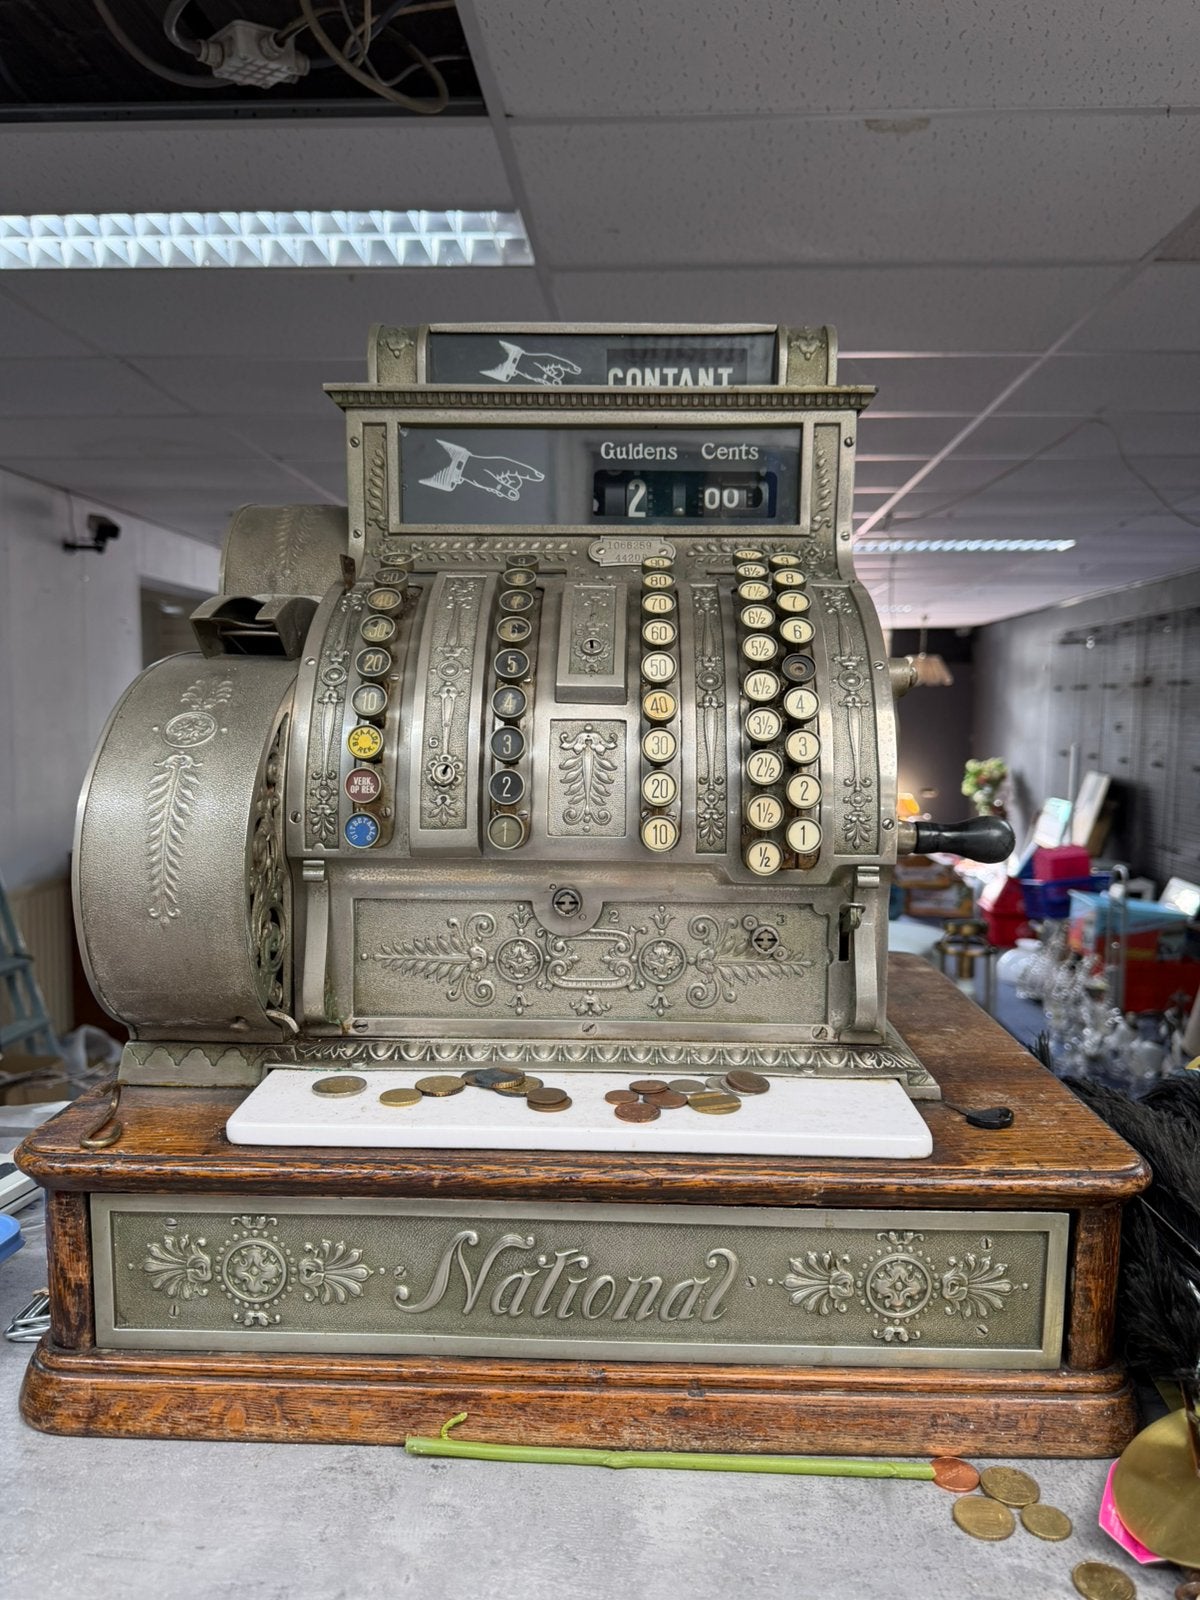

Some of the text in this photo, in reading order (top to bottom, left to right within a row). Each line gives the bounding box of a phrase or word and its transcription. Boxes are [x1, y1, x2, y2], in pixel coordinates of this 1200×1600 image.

[608, 367, 733, 386] CONTANT
[600, 441, 759, 460] Guldens Cents
[627, 479, 647, 518] 2
[650, 559, 665, 568] 90
[743, 567, 760, 576] 8½
[650, 576, 667, 586] 80
[785, 574, 794, 583] 8
[747, 586, 764, 597] 7½
[651, 598, 667, 611] 70
[789, 596, 797, 609] 7
[748, 610, 766, 624] 6½
[651, 626, 667, 641] 60
[793, 625, 802, 639] 6
[751, 640, 769, 656] 5½
[364, 654, 383, 671] 20
[507, 655, 517, 673] 5
[650, 659, 667, 677] 50
[752, 677, 772, 696] 4½
[362, 692, 377, 710] 10
[503, 692, 514, 712] 4
[650, 696, 668, 714] 40
[796, 694, 805, 713] 4
[753, 715, 774, 735] 3½
[352, 729, 378, 747] BETAALDE
[429, 736, 439, 748] 6
[503, 734, 512, 755] 3
[652, 735, 668, 755] 30
[799, 737, 807, 756] 3
[756, 757, 775, 778] 2½
[350, 785, 377, 794] OP REK.
[353, 777, 374, 786] VERK.
[502, 776, 512, 797] 2
[651, 778, 668, 799] 20
[800, 781, 809, 801] 2
[756, 802, 774, 823] 1½
[350, 817, 376, 841] UITBETAALD
[501, 821, 508, 843] 1
[652, 824, 668, 845] 10
[800, 825, 806, 846] 1
[609, 910, 619, 922] 2
[776, 912, 785, 926] 3
[395, 1230, 739, 1323] National
